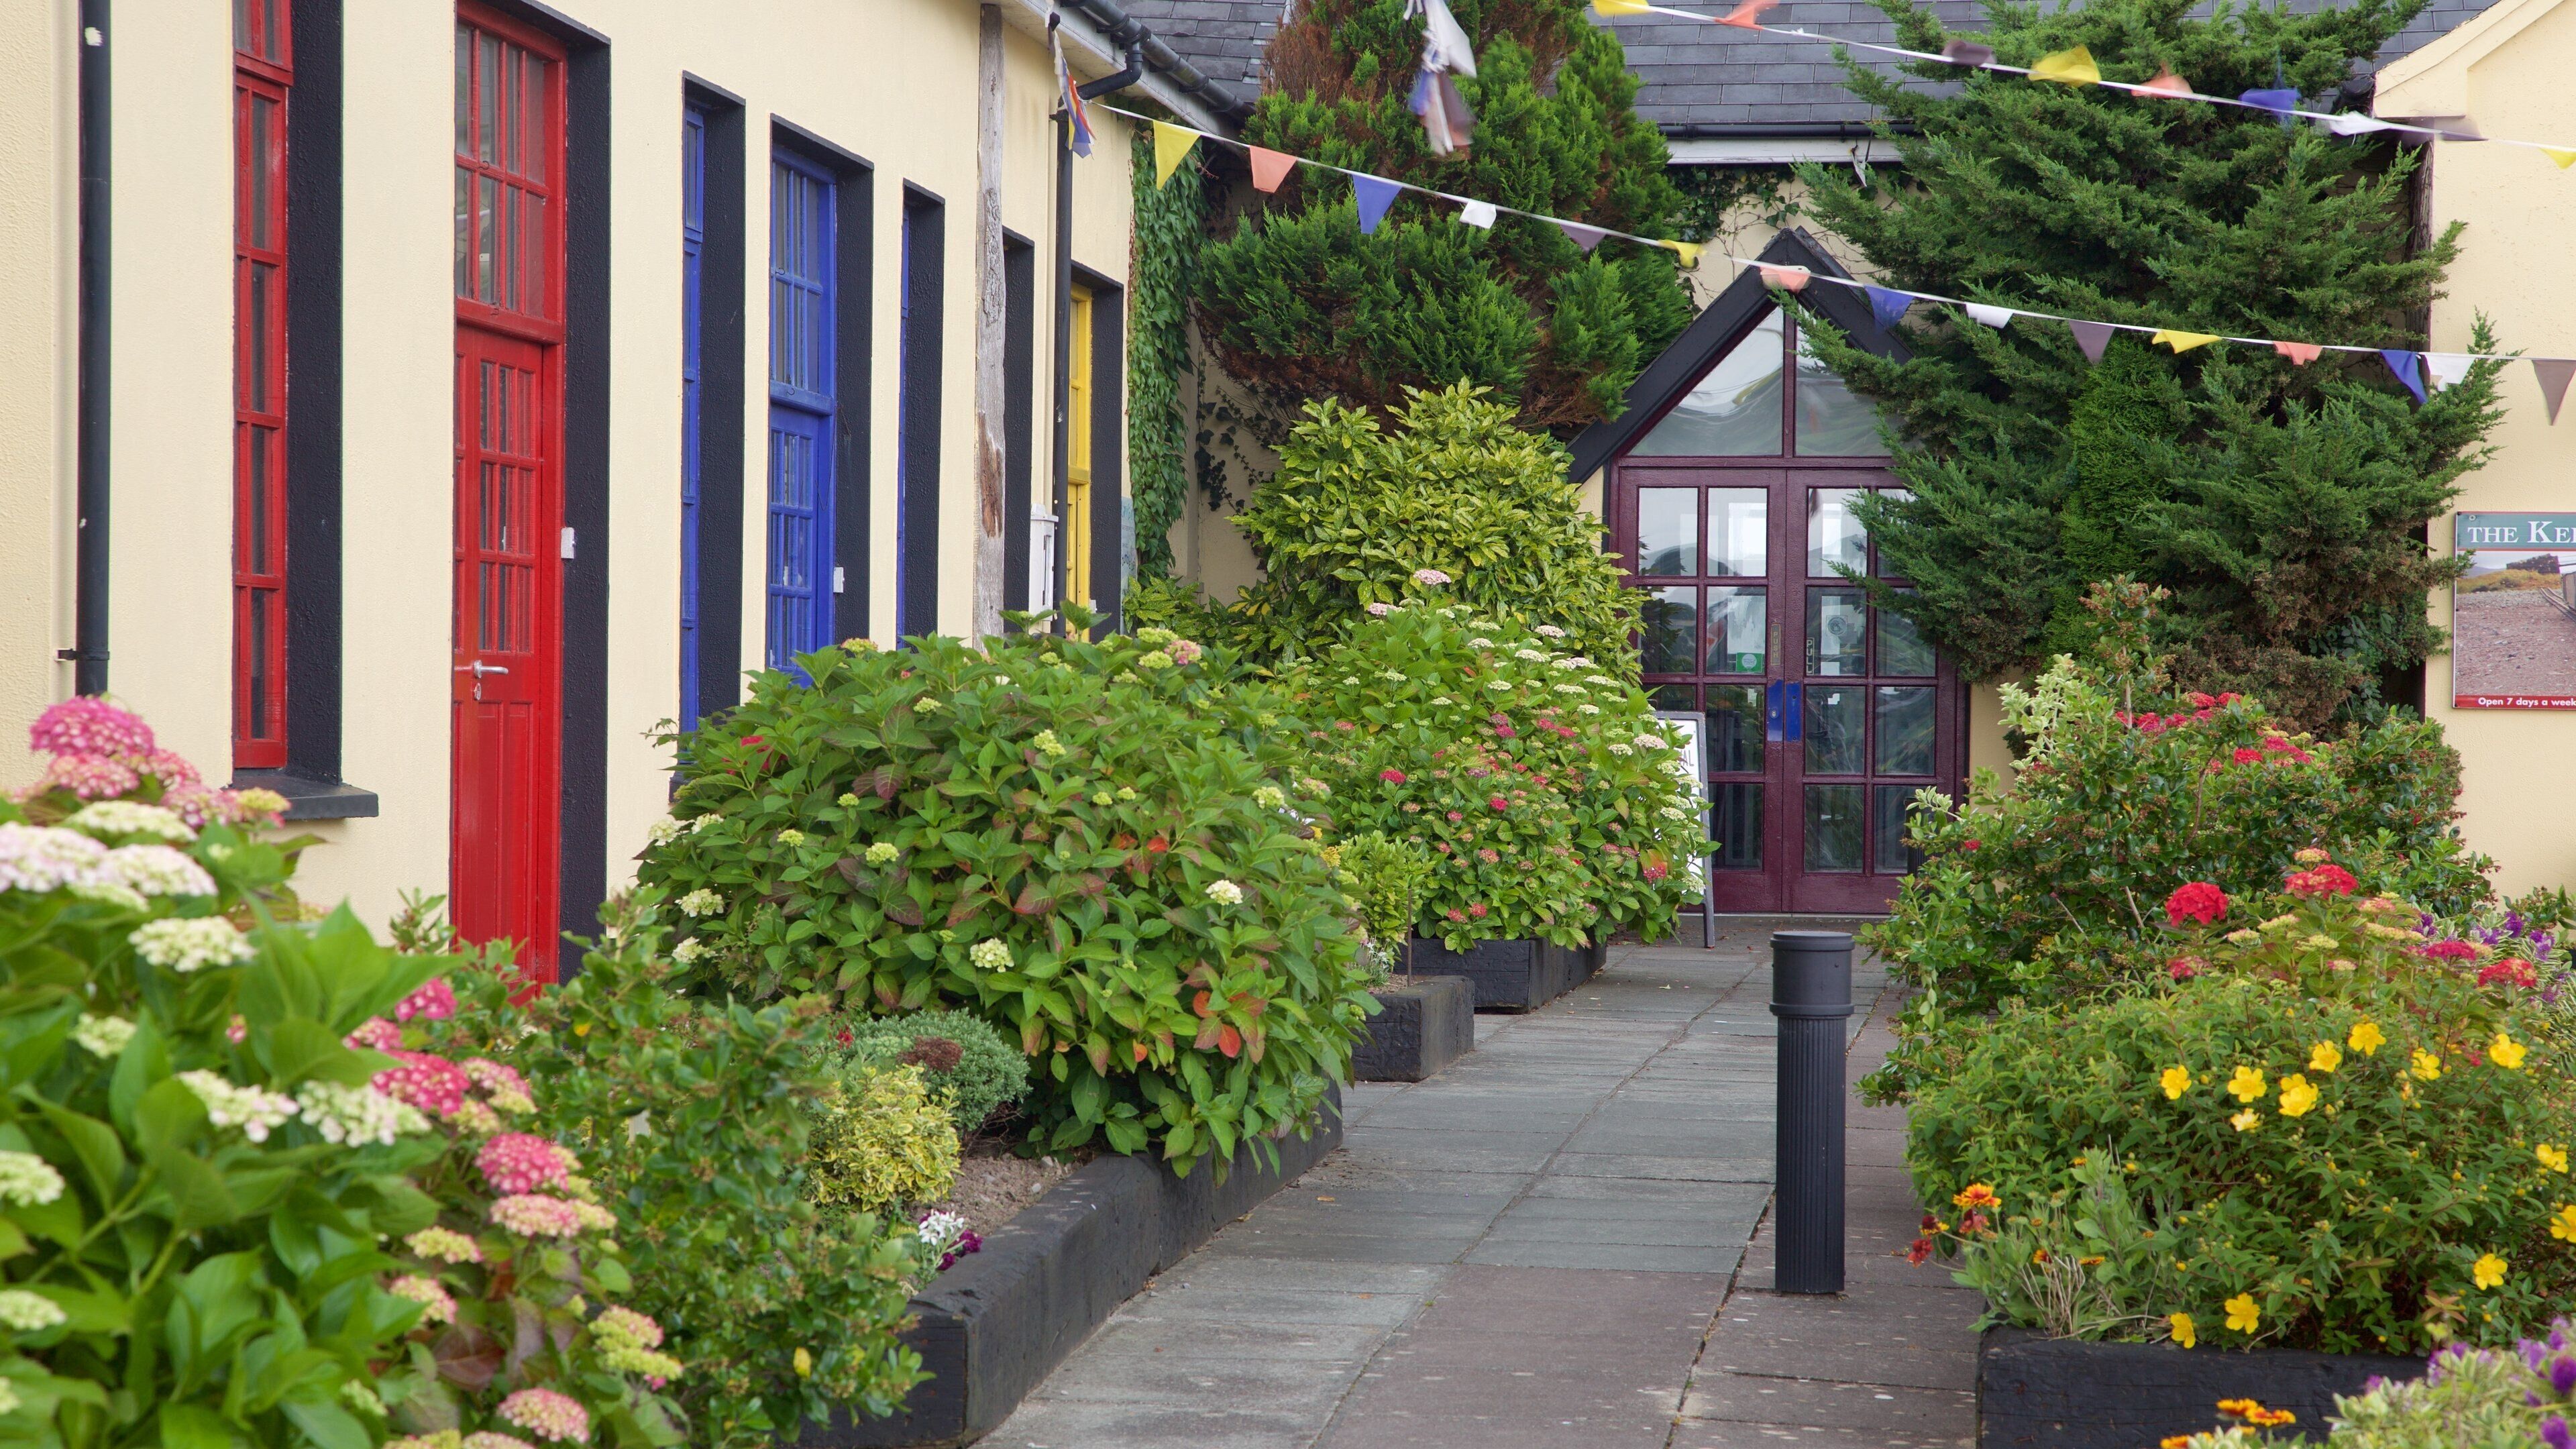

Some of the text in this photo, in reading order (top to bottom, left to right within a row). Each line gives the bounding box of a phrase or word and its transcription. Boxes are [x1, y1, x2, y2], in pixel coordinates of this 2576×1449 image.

[2467, 527, 2519, 543] THE
[2478, 697, 2504, 707] Open
[2516, 697, 2539, 707] days
[2551, 698, 2576, 706] week
